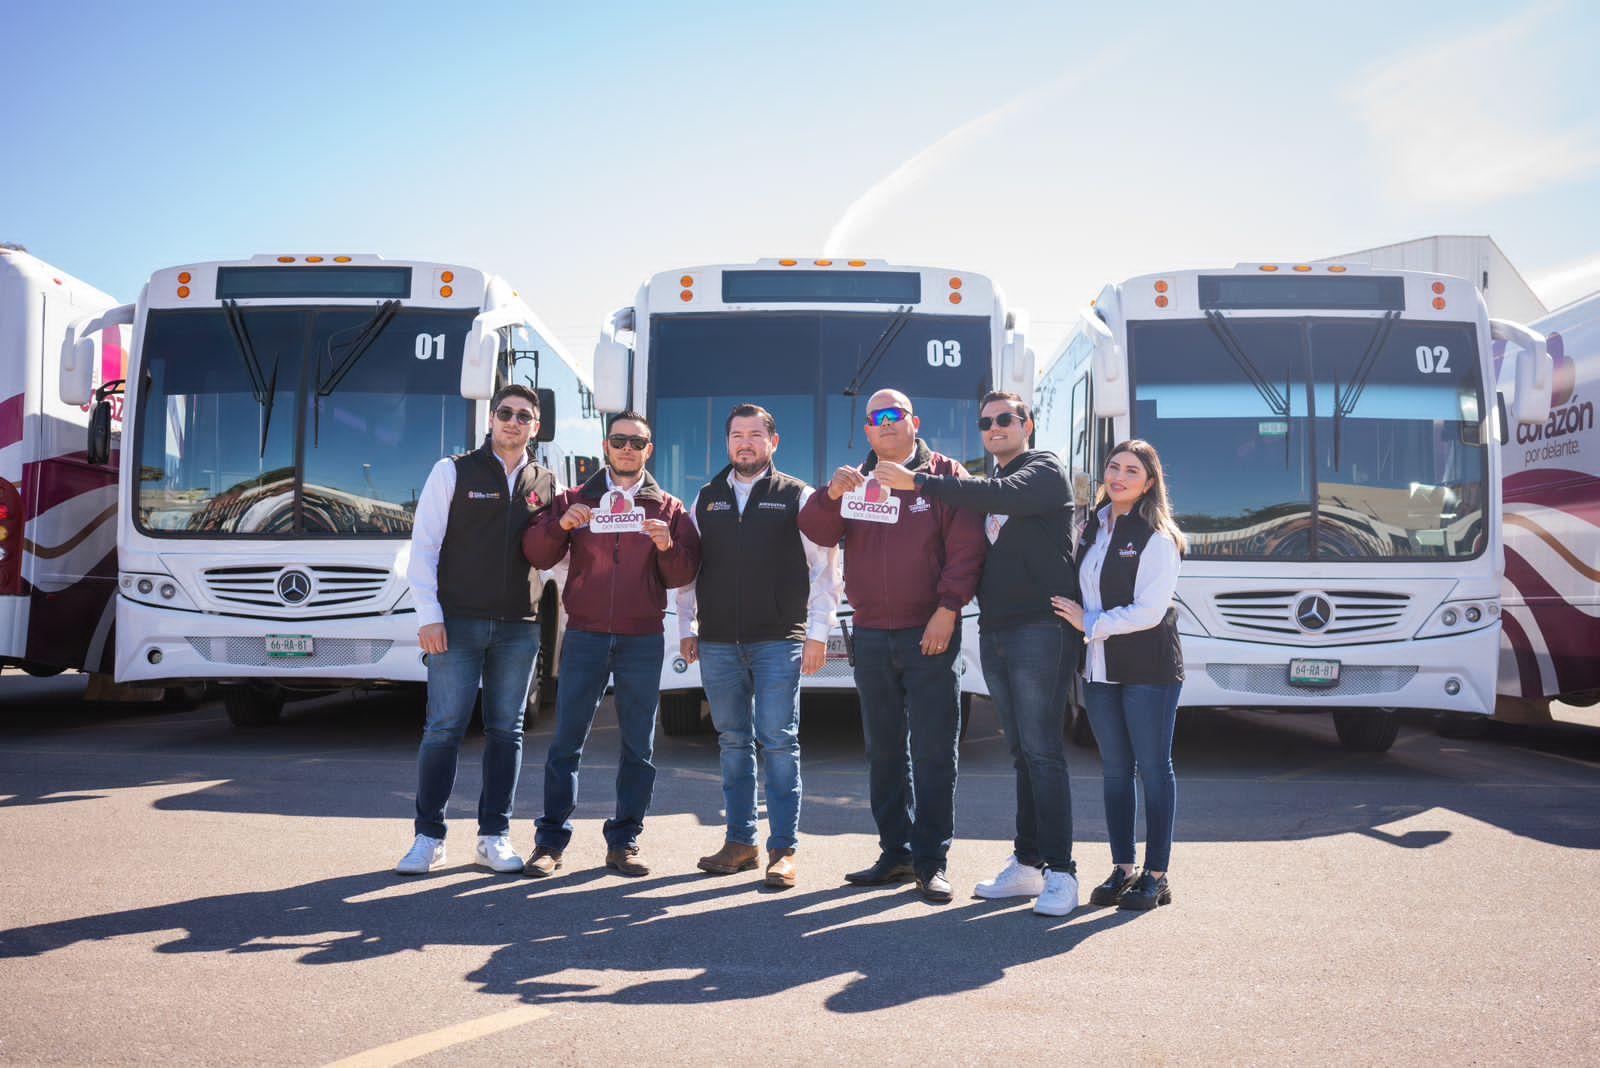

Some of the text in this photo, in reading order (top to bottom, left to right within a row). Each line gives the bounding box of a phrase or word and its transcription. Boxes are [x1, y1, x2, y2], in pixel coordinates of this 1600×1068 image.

[415, 333, 446, 360] 01
[927, 339, 962, 367] 03
[1416, 345, 1451, 373] 02
[1525, 447, 1540, 467] por
[595, 510, 644, 523] corazón
[848, 501, 898, 515] corazón
